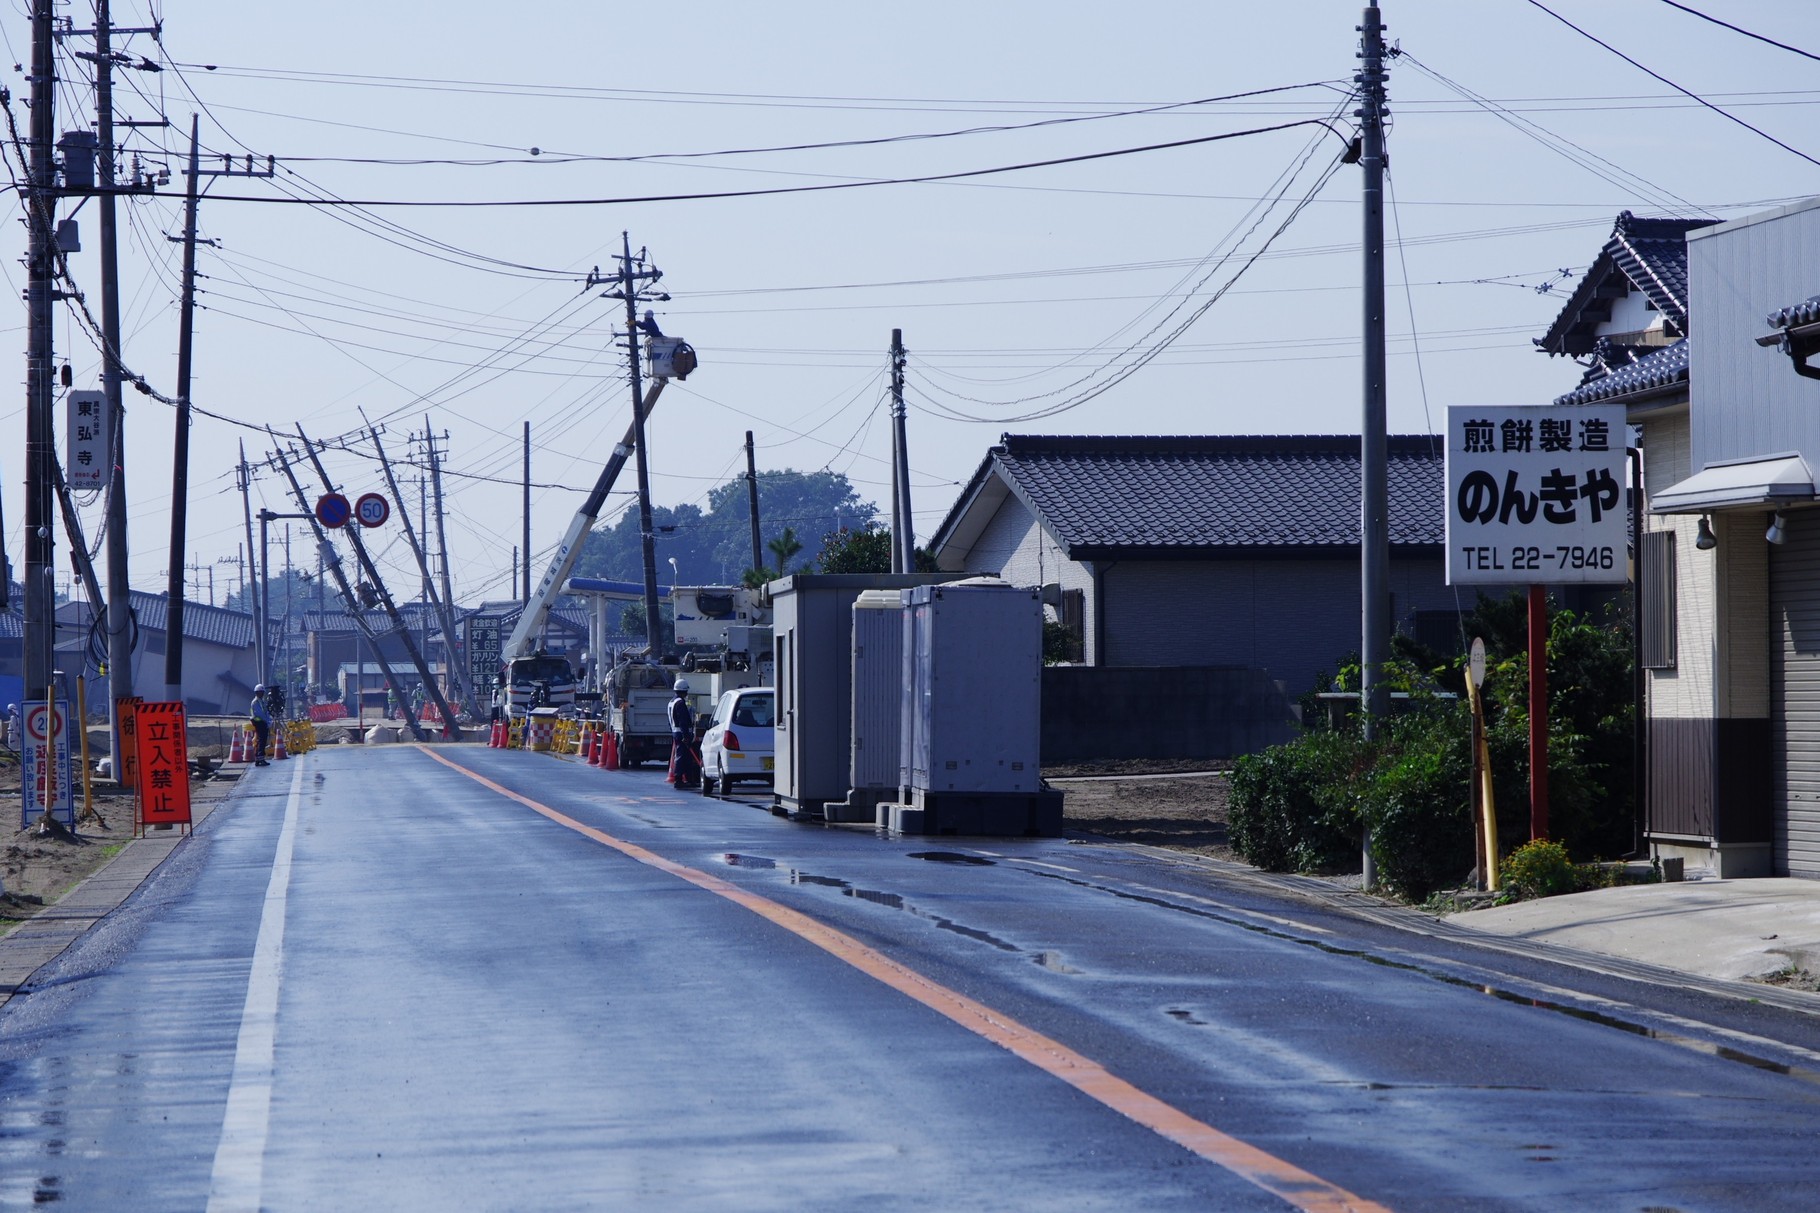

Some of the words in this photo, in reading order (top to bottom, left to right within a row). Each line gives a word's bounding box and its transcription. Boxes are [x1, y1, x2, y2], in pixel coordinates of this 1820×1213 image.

[77, 401, 93, 466] 東弘寺
[1463, 418, 1609, 453] 煎餅製造
[362, 503, 382, 518] 50
[1458, 467, 1619, 525] のんきや
[1463, 547, 1504, 570] TEL
[1512, 546, 1614, 570] 22-7946
[471, 651, 498, 662] ガソリン
[471, 662, 498, 673] ¥127
[57, 742, 67, 799] 工事中につき
[147, 721, 175, 813] 立入禁止
[171, 713, 184, 774] 工事関係者以外
[25, 747, 35, 808] お願い致します
